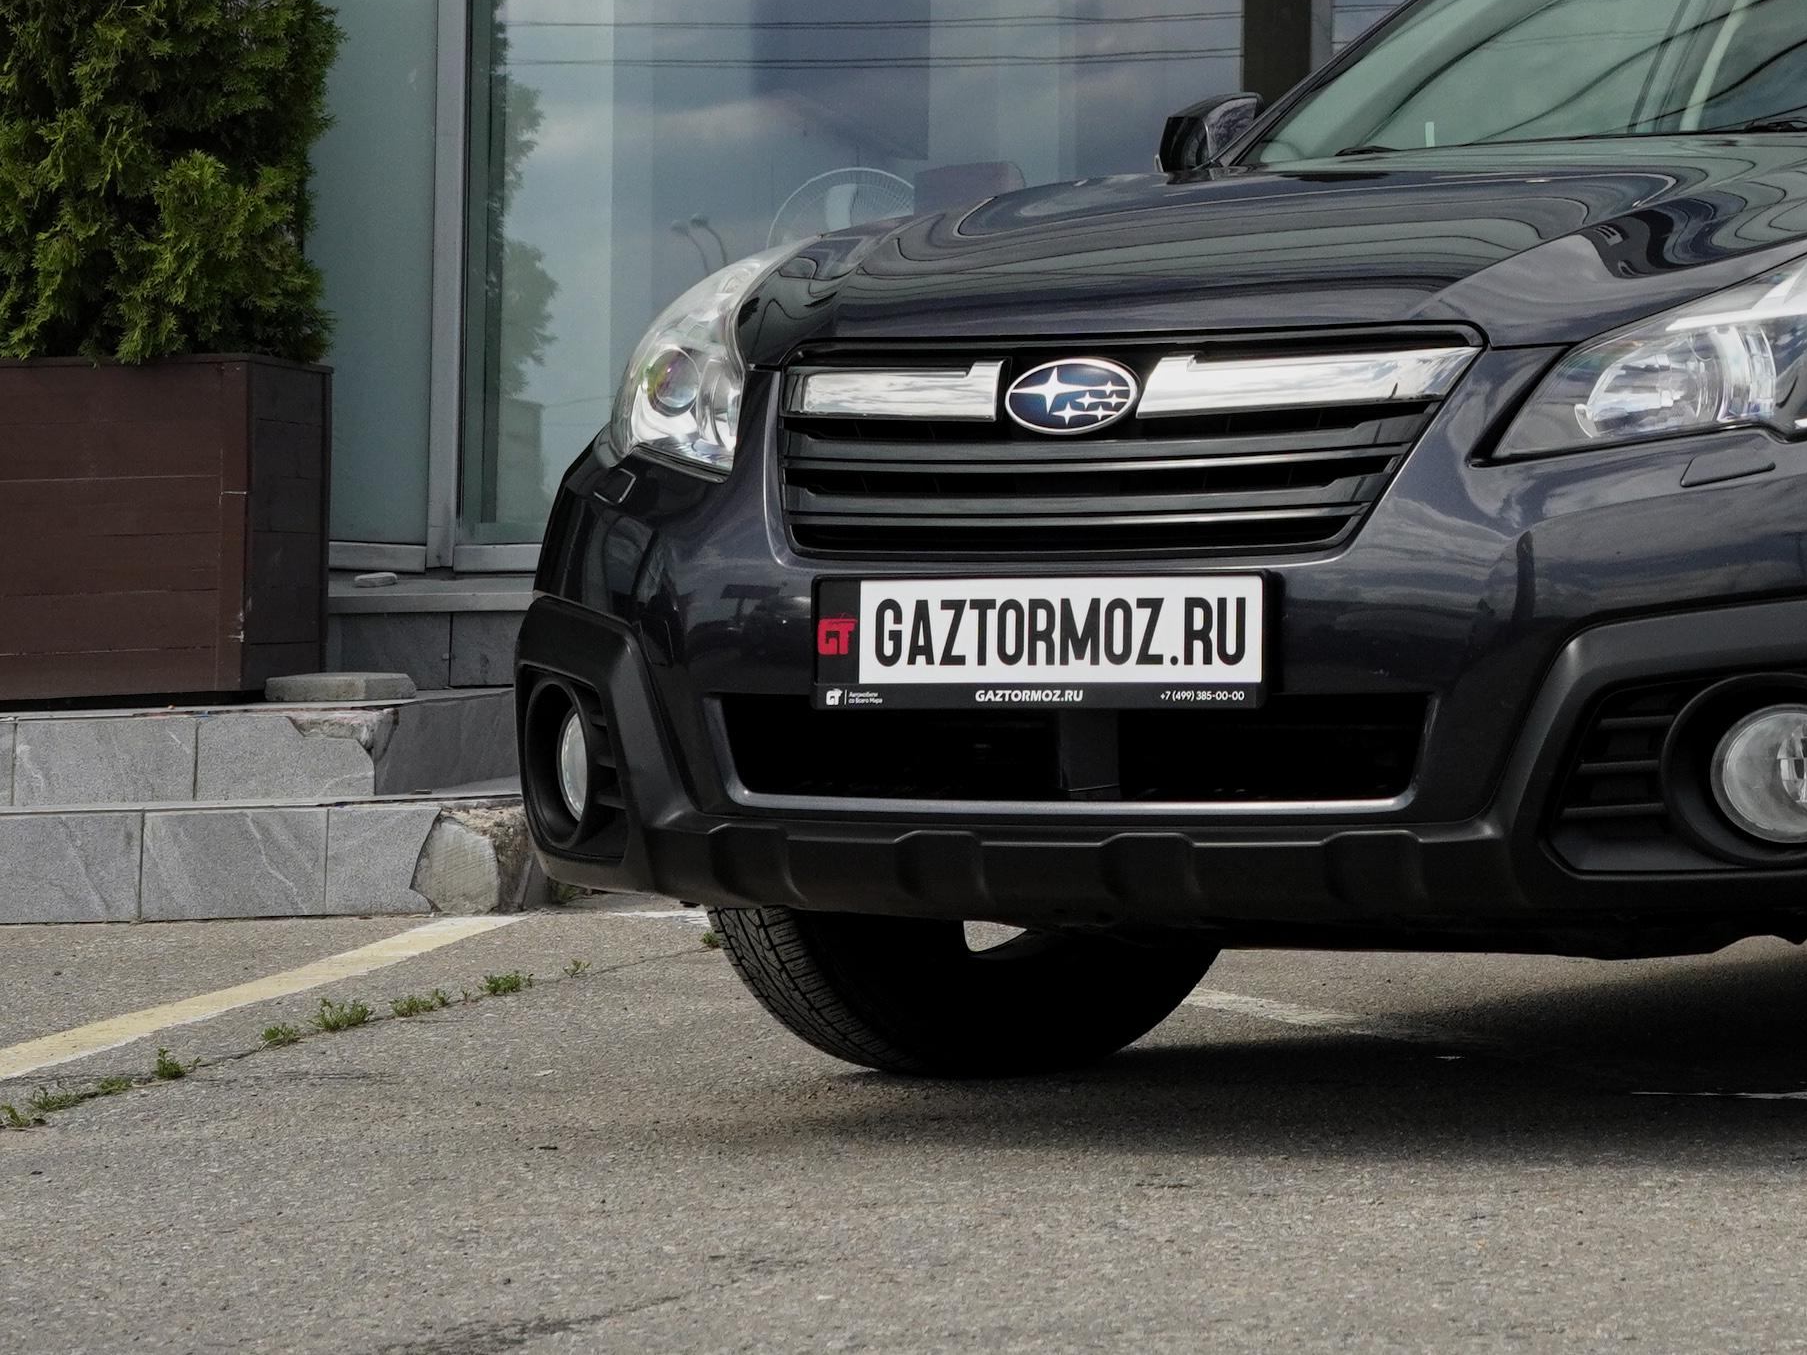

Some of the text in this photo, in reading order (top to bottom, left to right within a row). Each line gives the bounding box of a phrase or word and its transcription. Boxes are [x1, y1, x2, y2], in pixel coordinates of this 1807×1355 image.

[874, 596, 1247, 667] GAZTORMOZ.RU
[975, 689, 1084, 702] GAZTORMOZ.RU
[1160, 690, 1245, 702] +7 (499) 385-00-00
